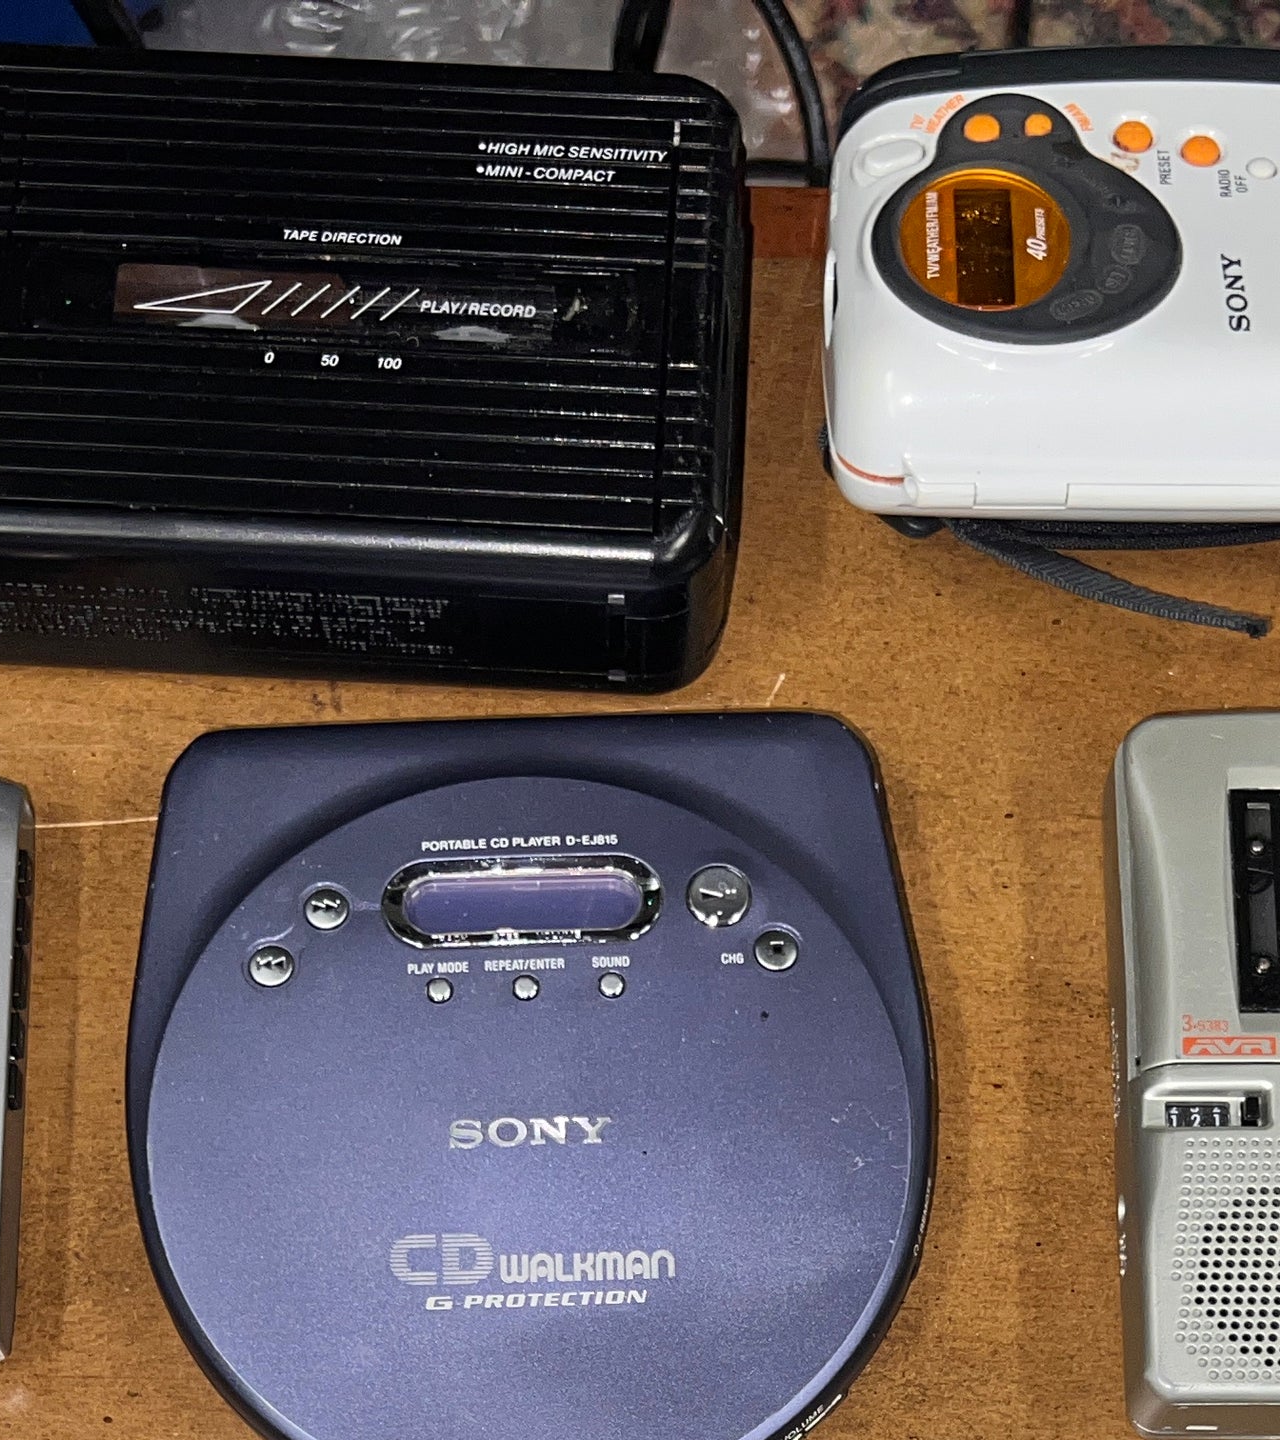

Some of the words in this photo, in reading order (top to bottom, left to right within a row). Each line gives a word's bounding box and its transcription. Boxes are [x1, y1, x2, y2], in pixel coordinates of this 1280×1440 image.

[924, 94, 965, 134] WEATHER
[487, 142, 531, 155] HIGH
[533, 144, 564, 157] MIC
[568, 146, 667, 162] SENSITIVITY
[1157, 150, 1172, 185] PRESET
[1220, 169, 1232, 198] RADIO
[1235, 175, 1248, 193] OFF
[283, 229, 318, 242] TAPE
[322, 230, 402, 246] DIRECTION
[1026, 236, 1048, 261] 40
[1220, 253, 1250, 332] SONY
[420, 300, 537, 318] PLAY/RECORD
[264, 352, 275, 364] 0
[321, 354, 339, 367] 50
[377, 357, 402, 370] 100
[421, 839, 487, 851] PORTABLE
[490, 838, 509, 848] CD
[512, 836, 561, 847] PLAYER
[566, 834, 618, 846] D-EJ815
[484, 958, 565, 972] REPEAT/ENTER
[592, 955, 630, 968] SOUND
[721, 952, 744, 965] CHG
[407, 962, 435, 975] PLAY
[437, 961, 469, 974] MODE
[449, 1116, 611, 1149] SONY
[390, 1233, 494, 1285] CD
[499, 1249, 675, 1284] WALKMAN
[425, 1296, 453, 1311] G
[463, 1289, 648, 1309] PROTECTION
